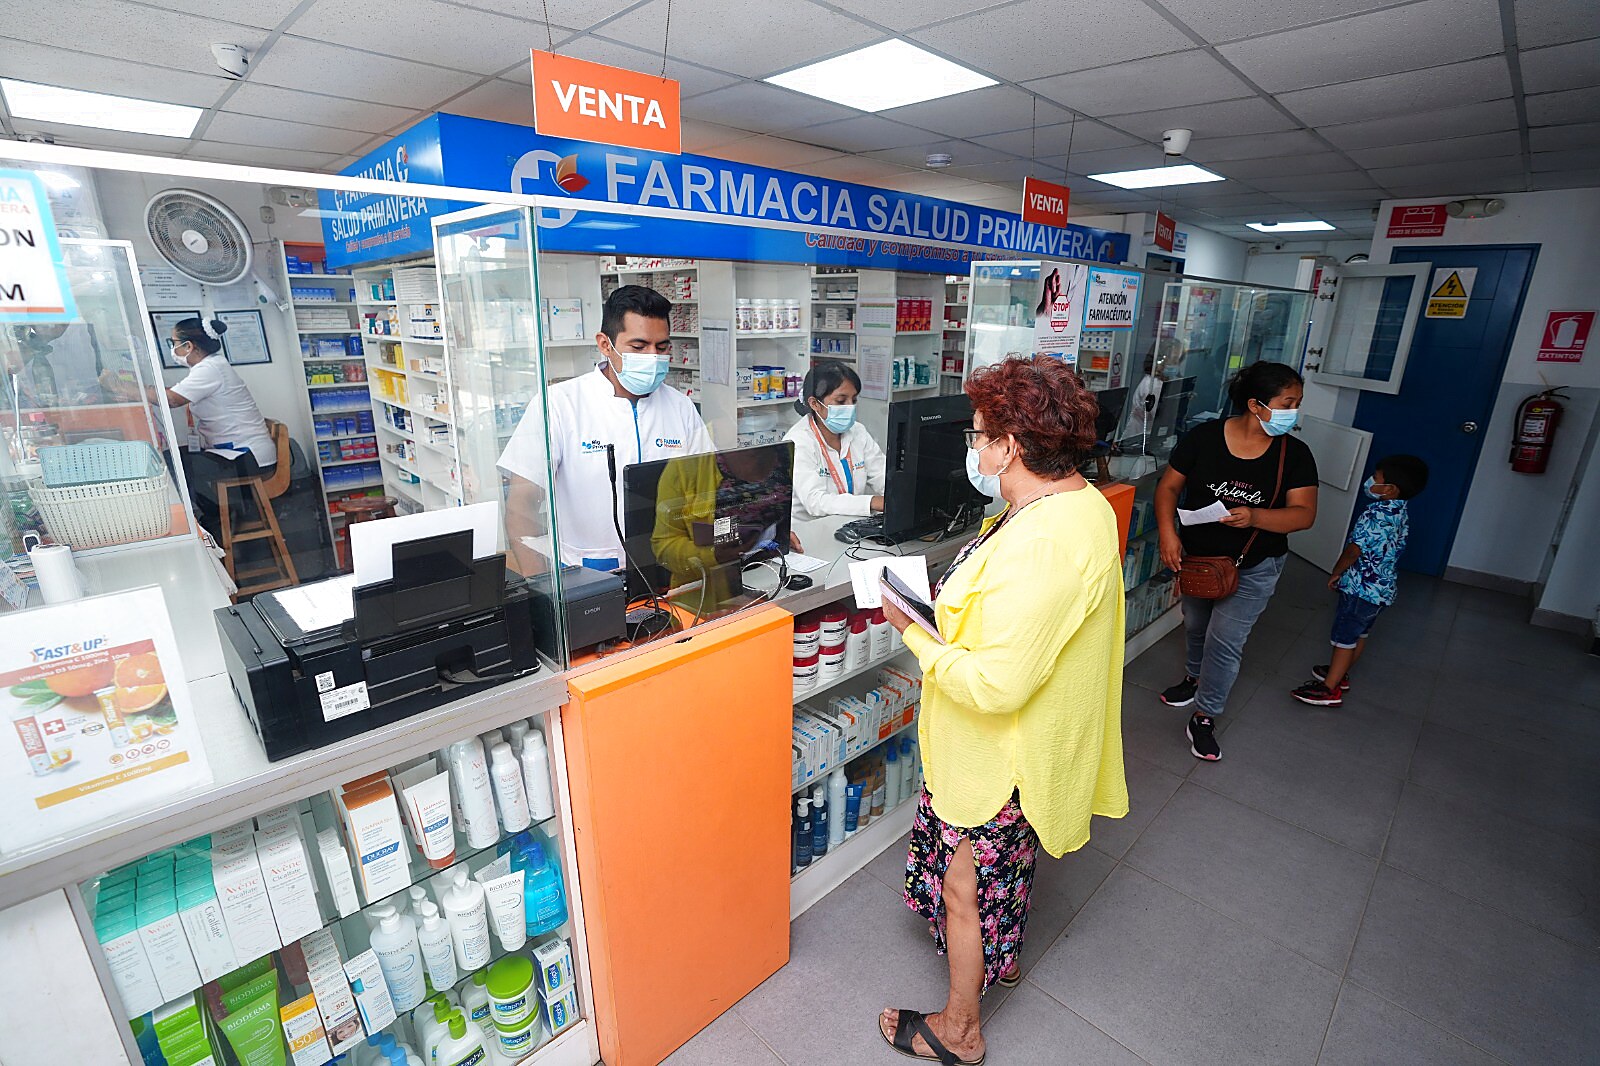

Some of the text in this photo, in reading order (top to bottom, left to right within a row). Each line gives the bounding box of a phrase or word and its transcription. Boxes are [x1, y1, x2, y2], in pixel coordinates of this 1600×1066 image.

[551, 80, 667, 129] VENTA
[605, 152, 1094, 260] FARMACIA SALUD PRIMAVERA
[1029, 192, 1065, 215] VENTA
[331, 195, 428, 242] SALUD PRIMAVERA
[1157, 222, 1172, 242] VENTA
[804, 231, 865, 252] Calidad
[868, 238, 877, 257] y
[881, 241, 960, 262] compromiso
[961, 250, 969, 262] a
[1053, 302, 1069, 312] STOP
[1098, 291, 1128, 306] ATENCIÓN
[1088, 307, 1132, 321] FARMACÉUTICA
[1538, 352, 1581, 360] EXTINTOR
[1207, 481, 1266, 505] friends
[31, 637, 104, 663] FAST&UP
[427, 818, 448, 832] DUCRAY
[366, 844, 395, 862] DUCRAY
[489, 878, 521, 893] BIODERMA
[229, 979, 273, 1005] BIODERMA
[496, 997, 526, 1012] Cetaphil
[227, 1002, 272, 1031] BIODERMA
[501, 1033, 529, 1046] Cetaphil
